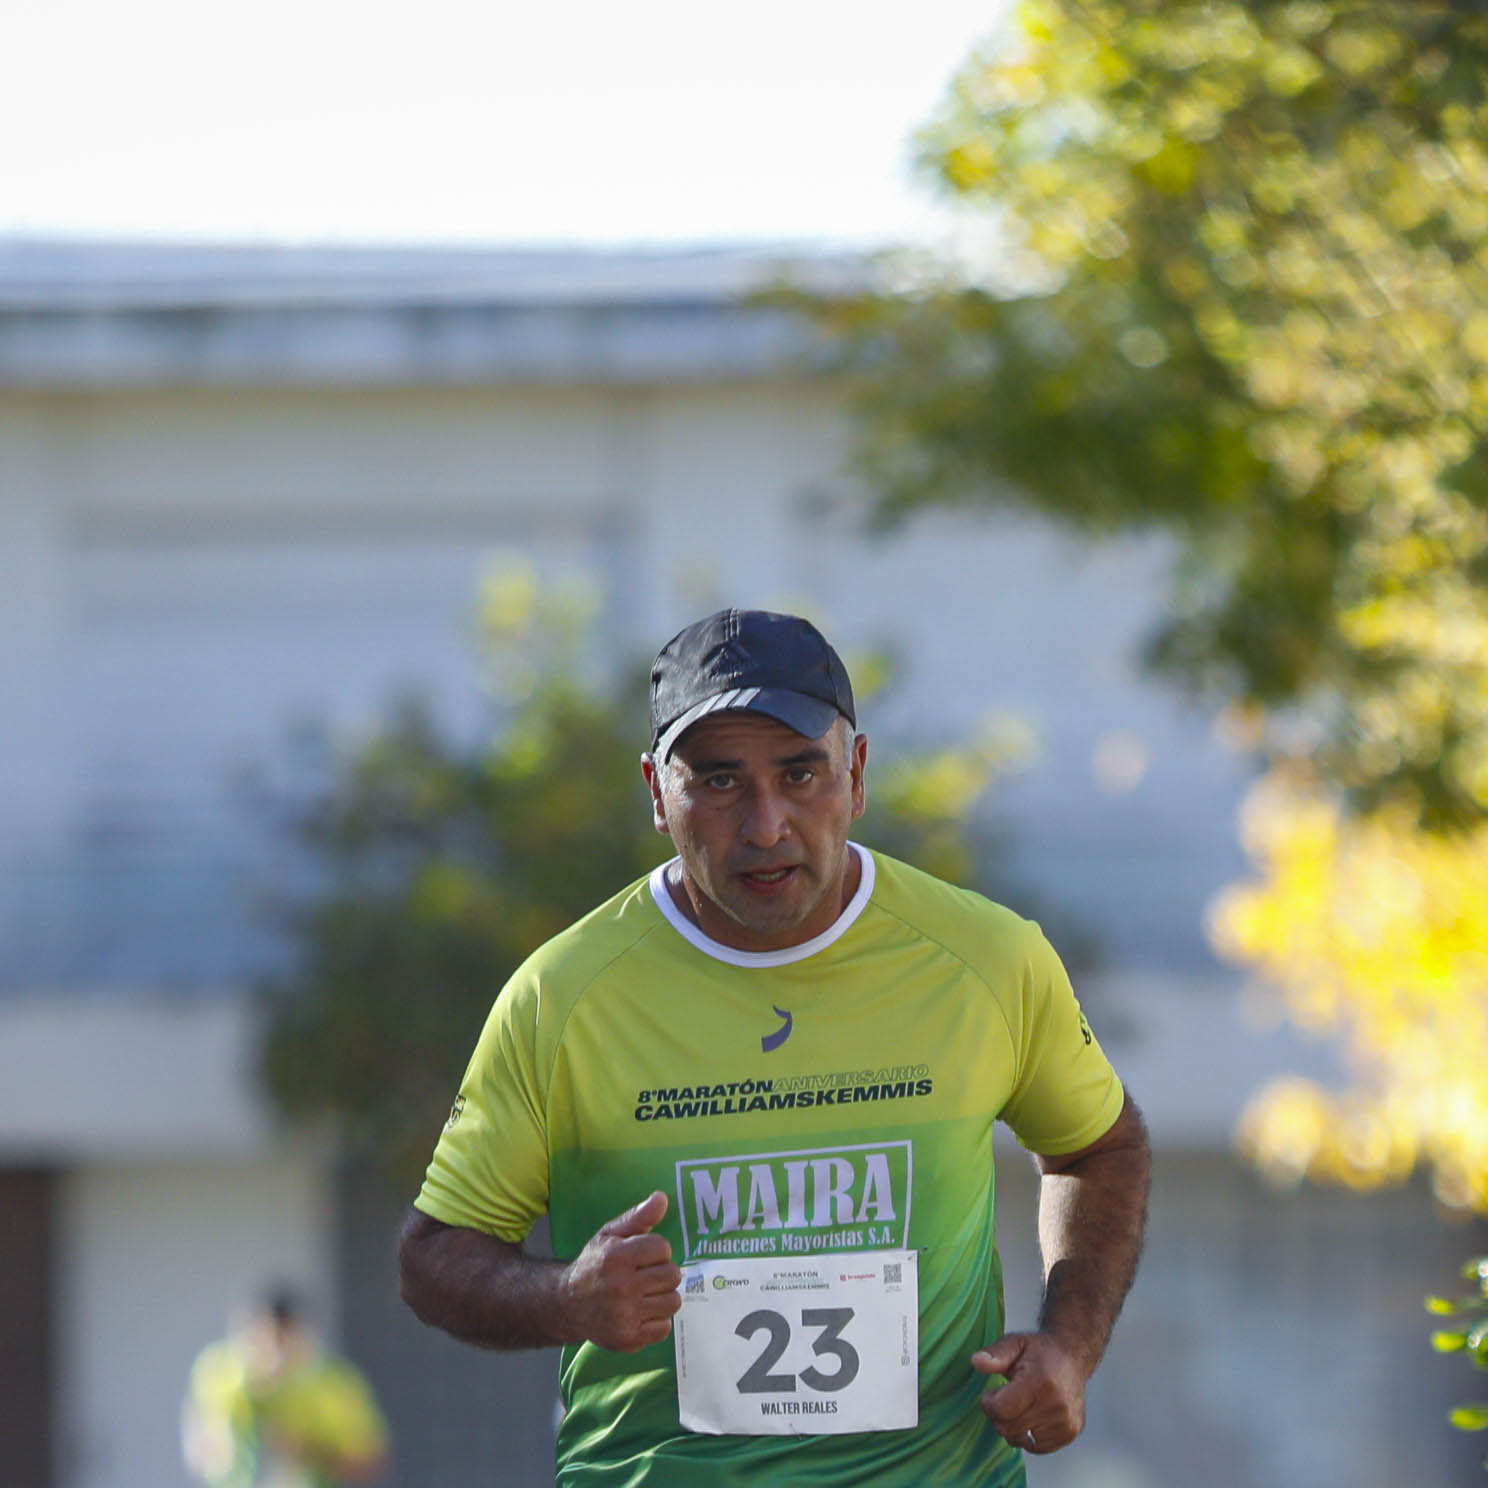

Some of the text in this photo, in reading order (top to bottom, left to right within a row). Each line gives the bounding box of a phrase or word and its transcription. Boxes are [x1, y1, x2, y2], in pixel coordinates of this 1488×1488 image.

[635, 1079, 933, 1122] CAWILLIAMSKEMMIS
[690, 1153, 896, 1235] MAIRA
[781, 1227, 863, 1251] Mayoristas
[868, 1226, 895, 1245] S.A.
[735, 1307, 860, 1394] 23
[761, 1401, 838, 1416] WALTER REALES
